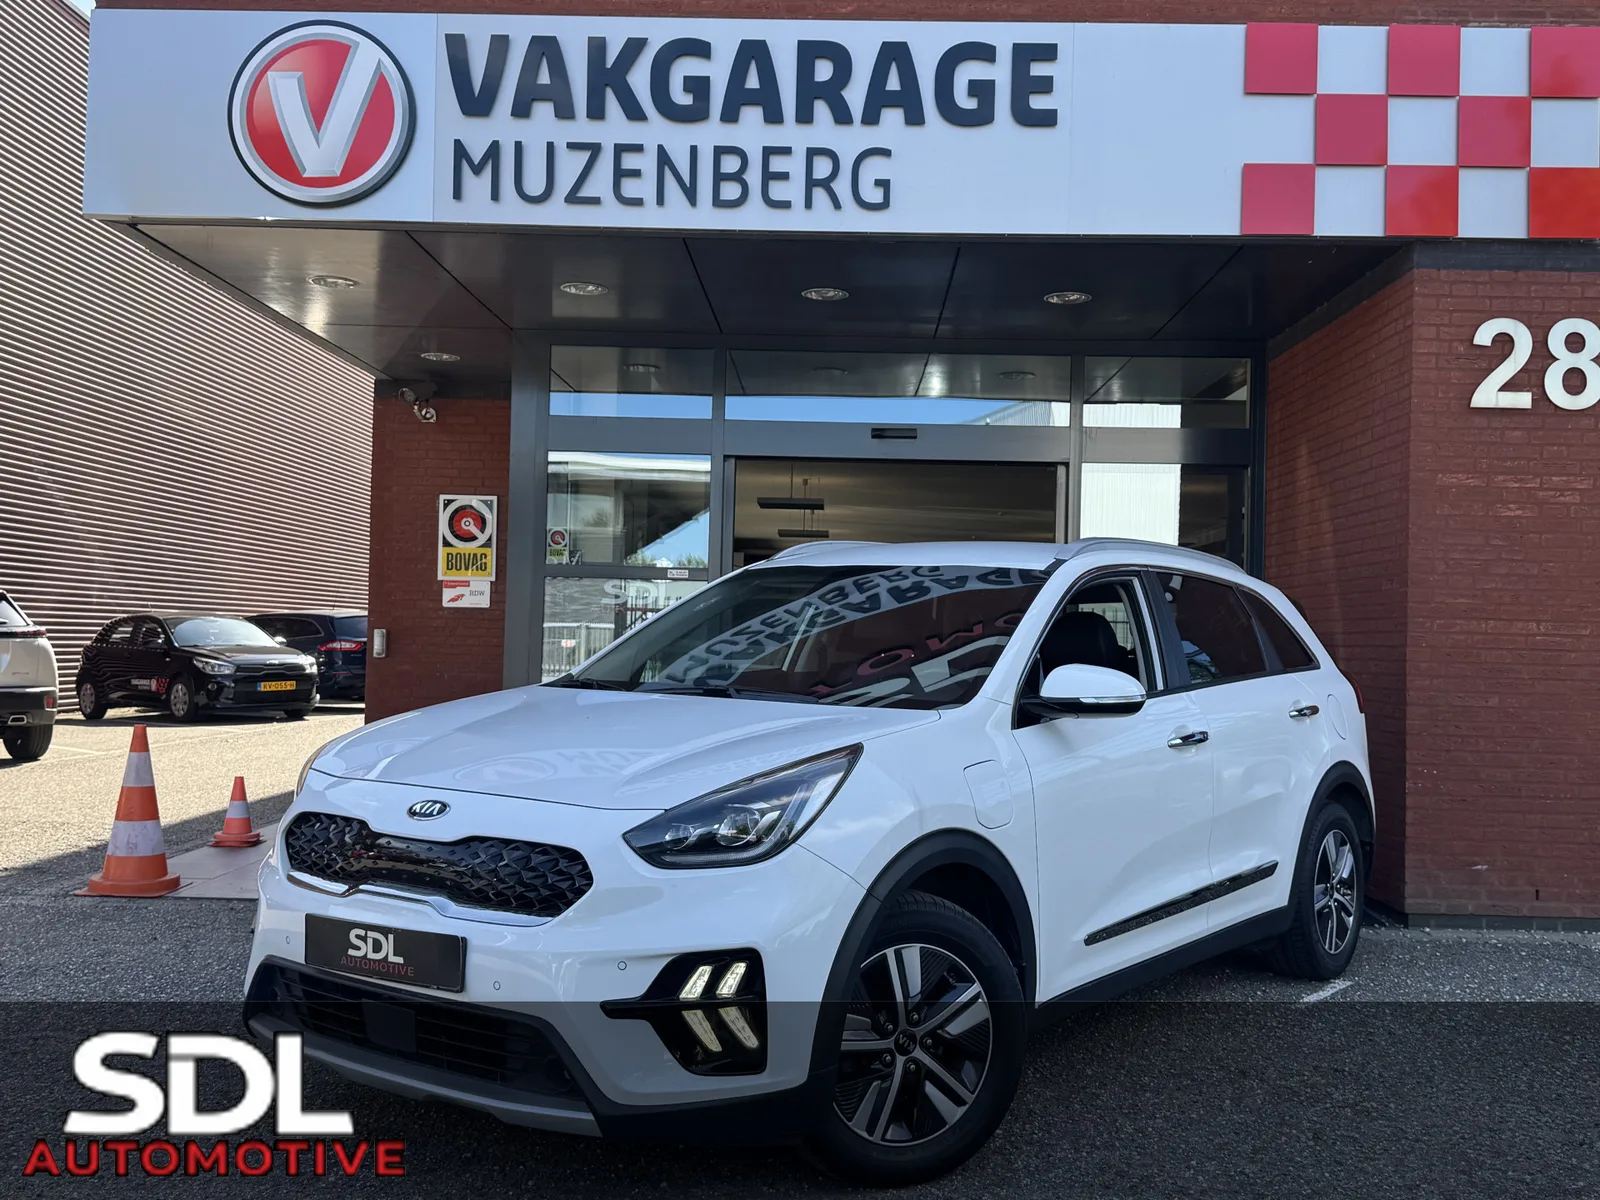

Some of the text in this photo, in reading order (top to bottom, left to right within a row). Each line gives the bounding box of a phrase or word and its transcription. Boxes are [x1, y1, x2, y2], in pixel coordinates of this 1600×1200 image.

[444, 33, 1058, 128] VAKGARAGE
[452, 138, 893, 211] MUZENBERG
[1469, 317, 1600, 411] 28
[446, 552, 488, 572] BOVAG
[410, 802, 442, 815] KIA
[347, 928, 404, 964] SDL
[340, 955, 414, 977] AUTOMOTIVE
